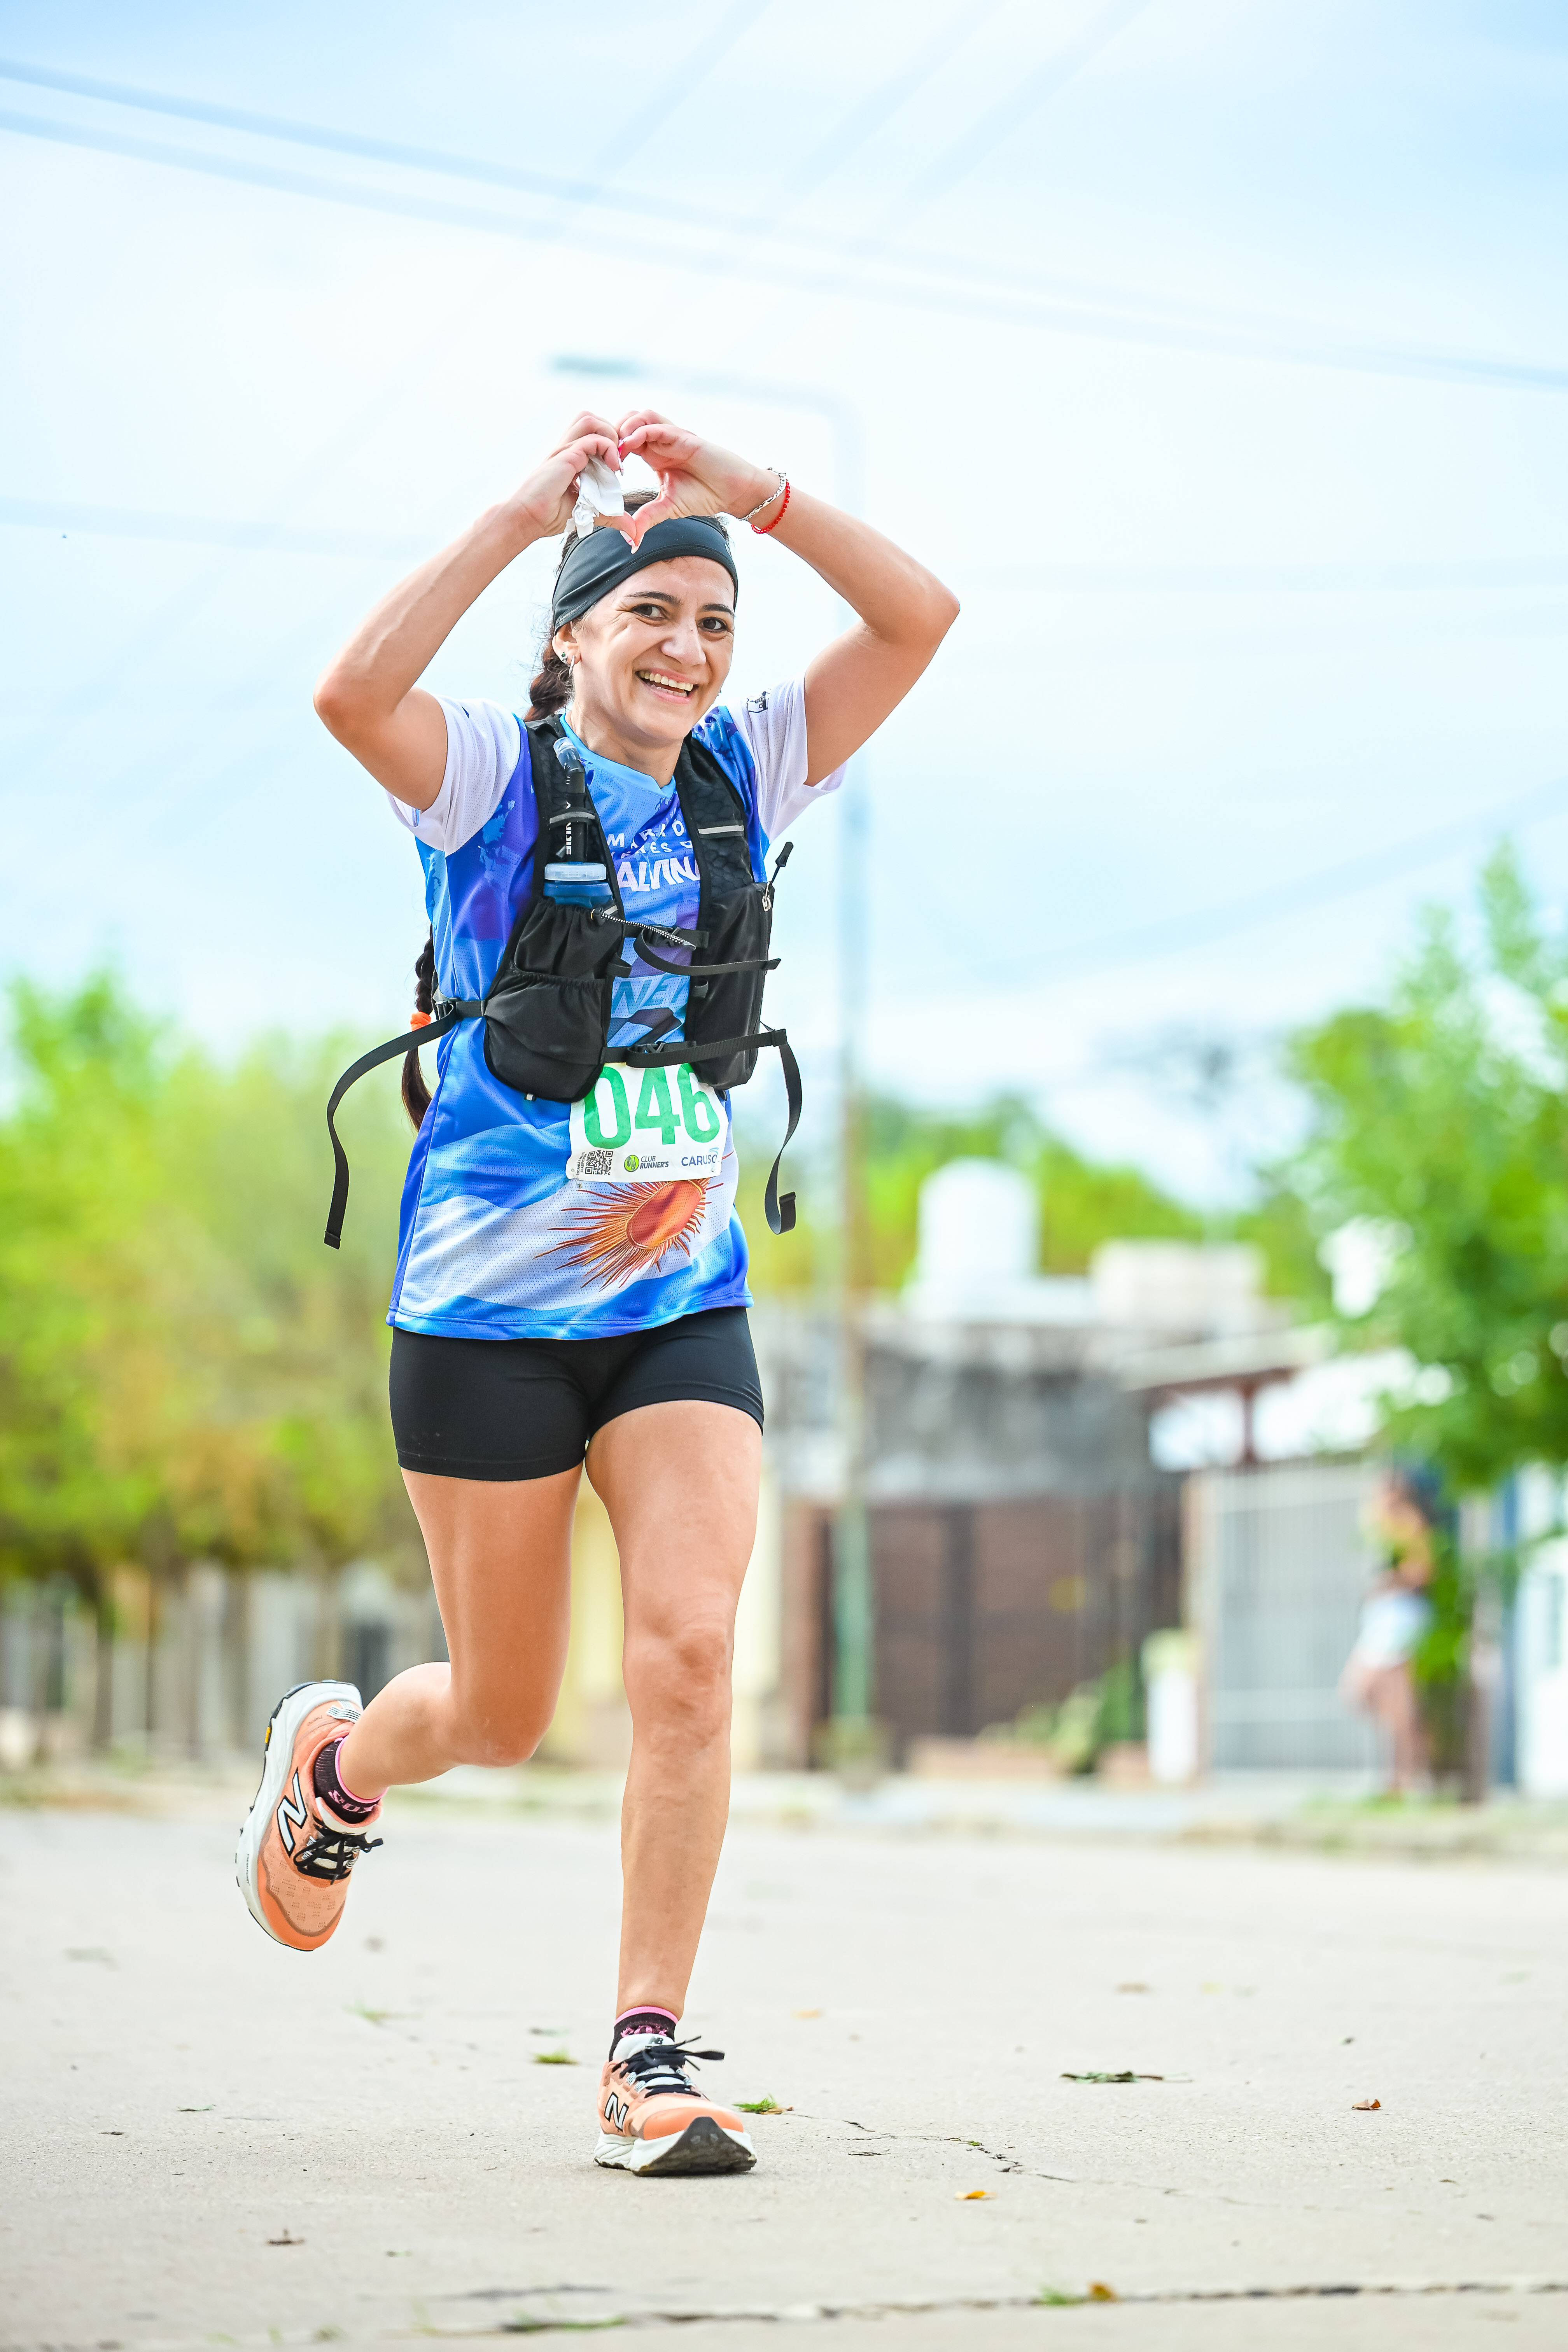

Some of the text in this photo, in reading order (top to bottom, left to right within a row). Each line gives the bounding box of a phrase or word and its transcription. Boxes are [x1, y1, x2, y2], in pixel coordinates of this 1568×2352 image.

[617, 856, 700, 891] ALVIN
[584, 1063, 720, 1149] 046
[681, 1154, 717, 1166] CARUSO
[604, 2091, 629, 2132] N
